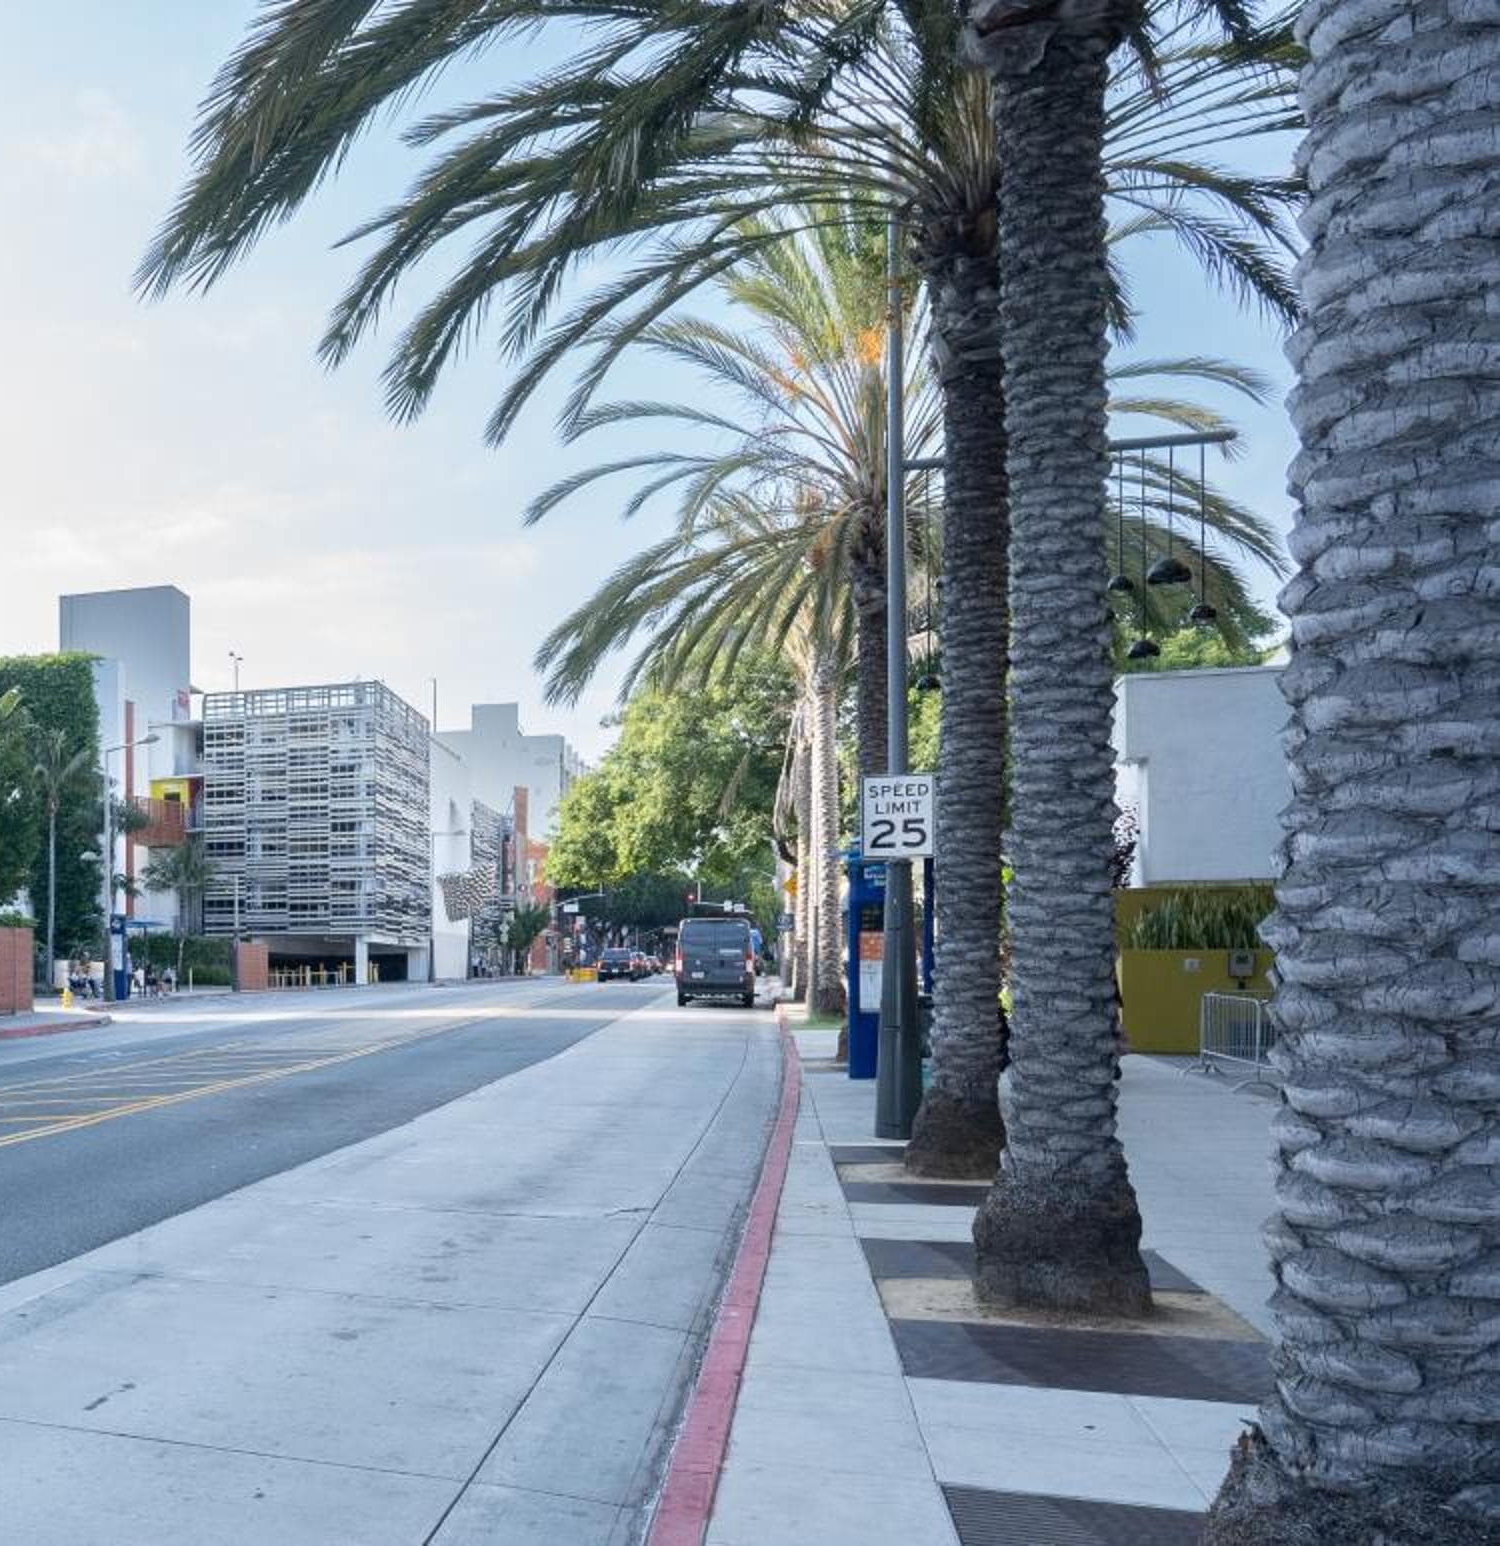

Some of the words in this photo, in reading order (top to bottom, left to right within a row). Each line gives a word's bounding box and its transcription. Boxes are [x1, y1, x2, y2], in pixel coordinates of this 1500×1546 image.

[869, 783, 929, 798] SPEED
[875, 801, 921, 815] LIMIT
[870, 818, 927, 848] 25
